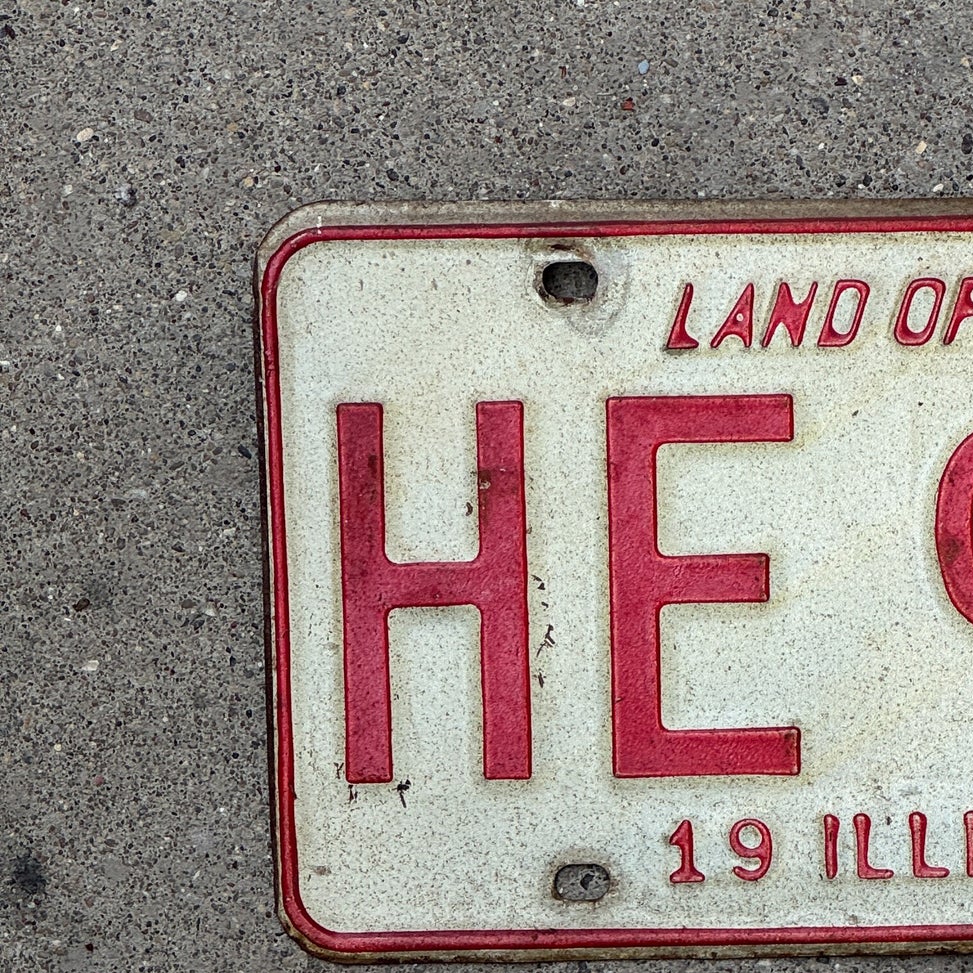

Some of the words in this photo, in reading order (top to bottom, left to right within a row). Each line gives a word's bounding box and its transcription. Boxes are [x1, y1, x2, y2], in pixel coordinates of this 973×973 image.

[667, 278, 871, 350] LAND
[335, 393, 802, 785] HE
[668, 818, 773, 884] 19
